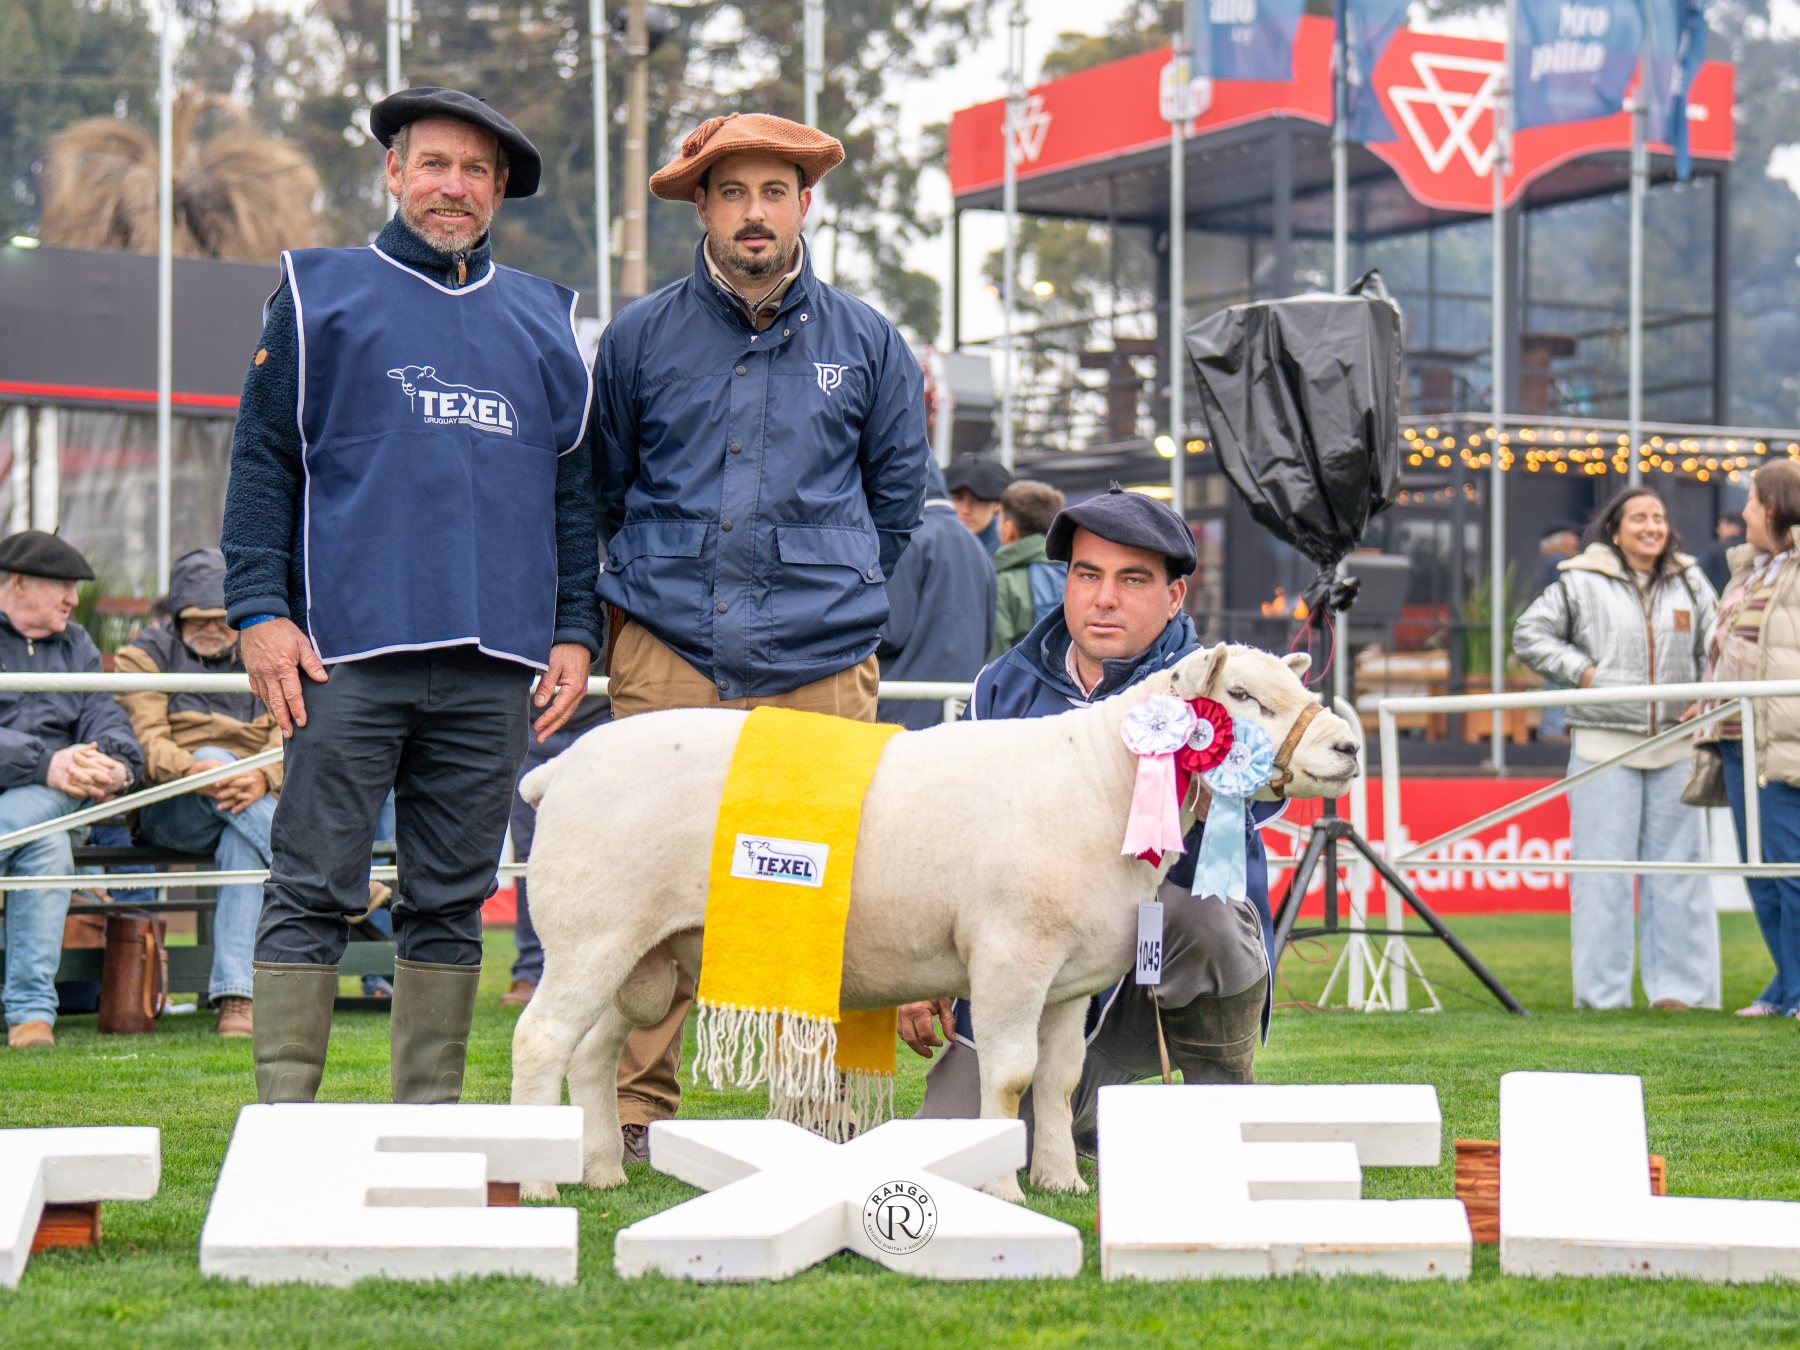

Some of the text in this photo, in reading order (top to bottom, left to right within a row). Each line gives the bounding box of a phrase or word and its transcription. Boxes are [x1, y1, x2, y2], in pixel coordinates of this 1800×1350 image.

[418, 390, 513, 428] TEXEL
[423, 417, 458, 425] URUGUAY
[757, 856, 812, 877] TEXEL
[1138, 940, 1161, 972] 1045
